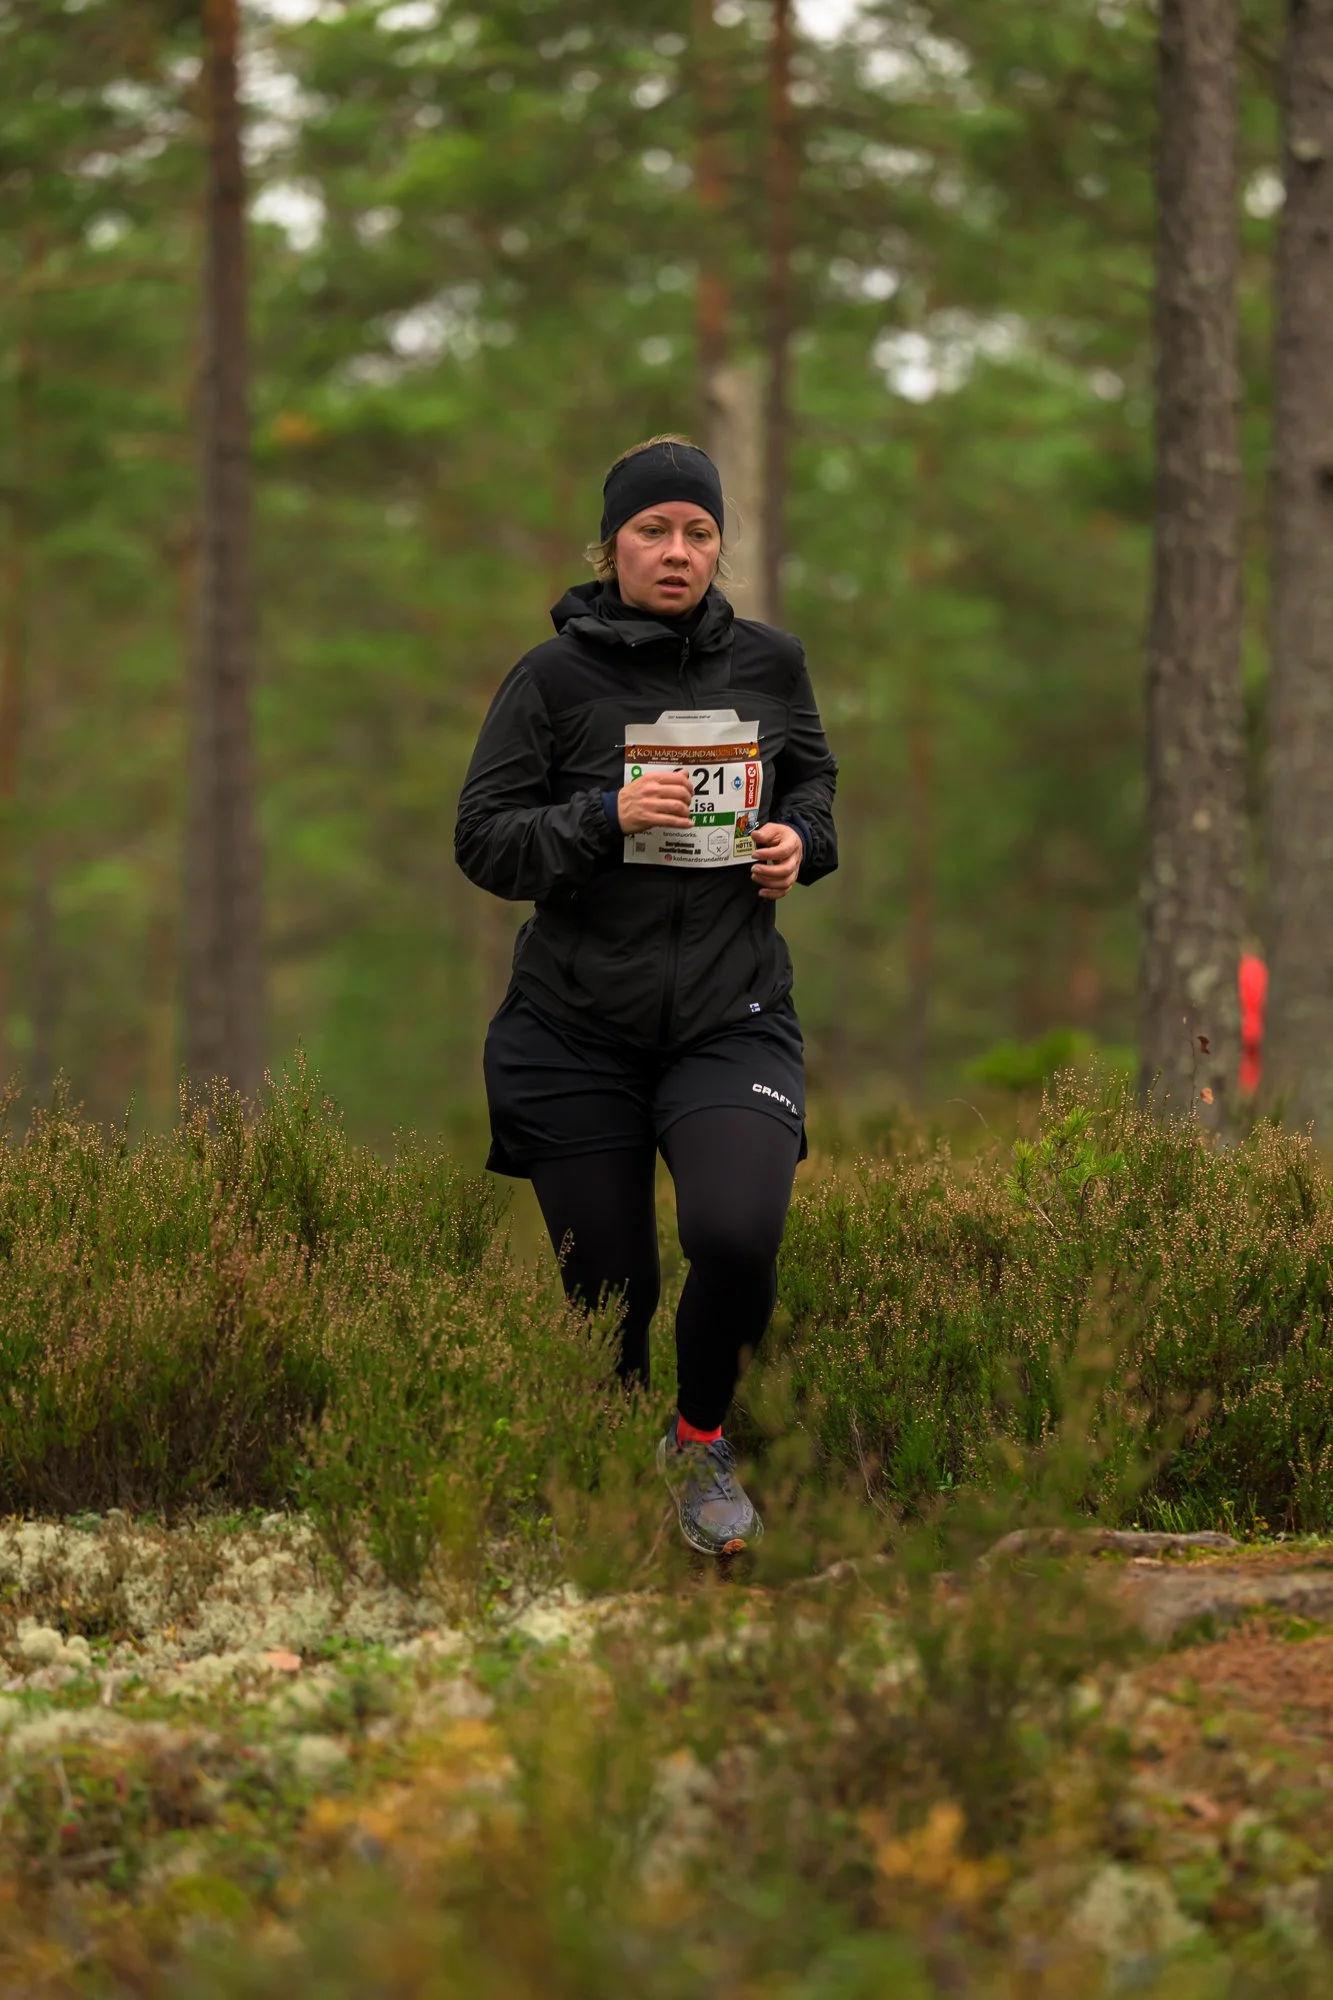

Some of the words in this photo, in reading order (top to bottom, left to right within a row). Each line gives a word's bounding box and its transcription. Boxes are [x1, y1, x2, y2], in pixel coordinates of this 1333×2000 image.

[673, 766, 725, 796] 21
[690, 799, 715, 813] isa
[752, 1083, 791, 1107] CRAFT
